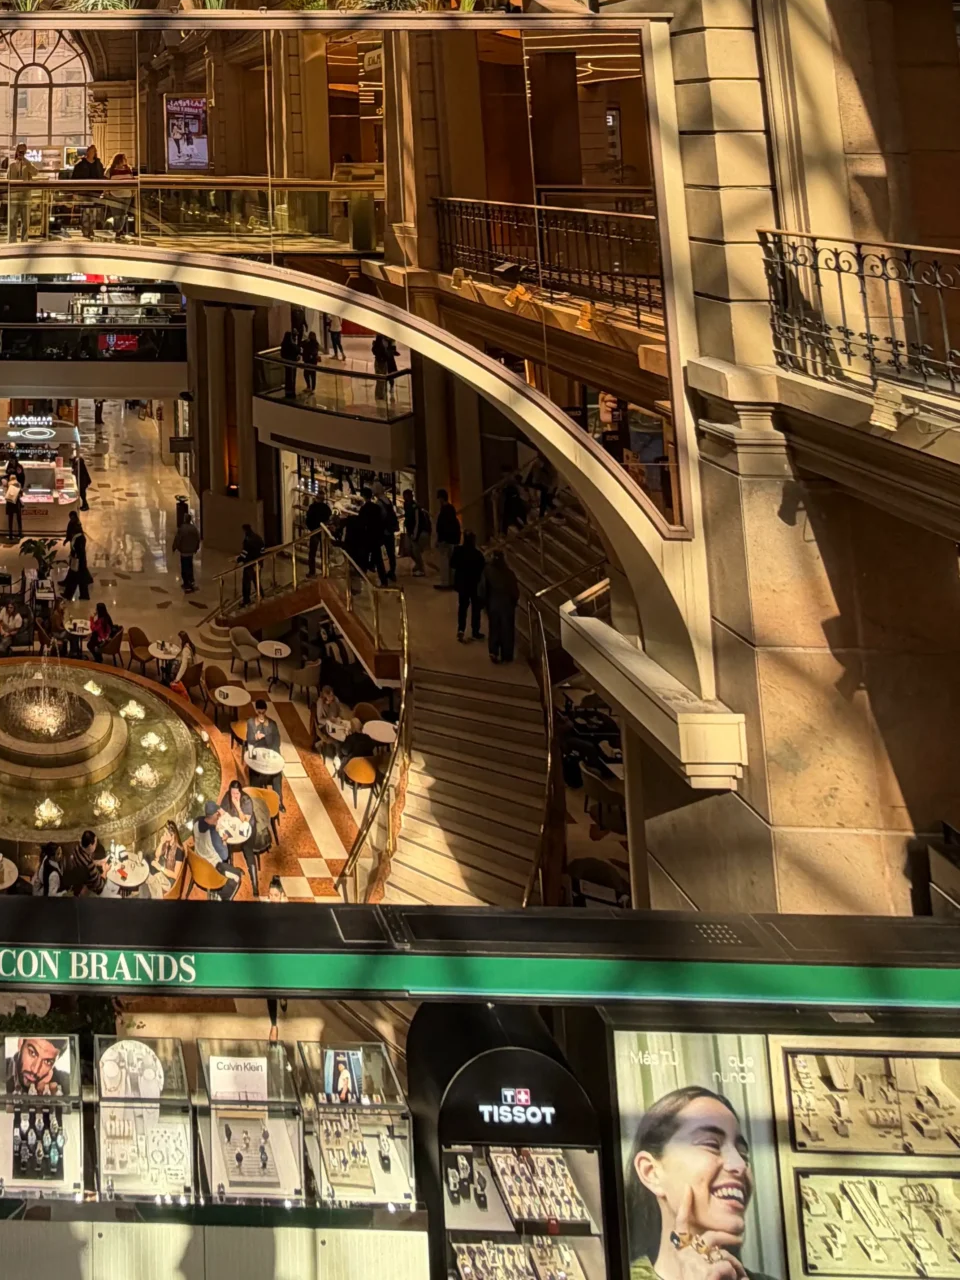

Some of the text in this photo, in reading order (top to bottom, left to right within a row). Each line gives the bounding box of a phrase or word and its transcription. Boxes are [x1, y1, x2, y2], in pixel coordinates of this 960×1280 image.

[68, 951, 197, 983] BRANDS
[216, 1061, 263, 1072] Calvin Klein
[478, 1104, 556, 1125] TISSOT
